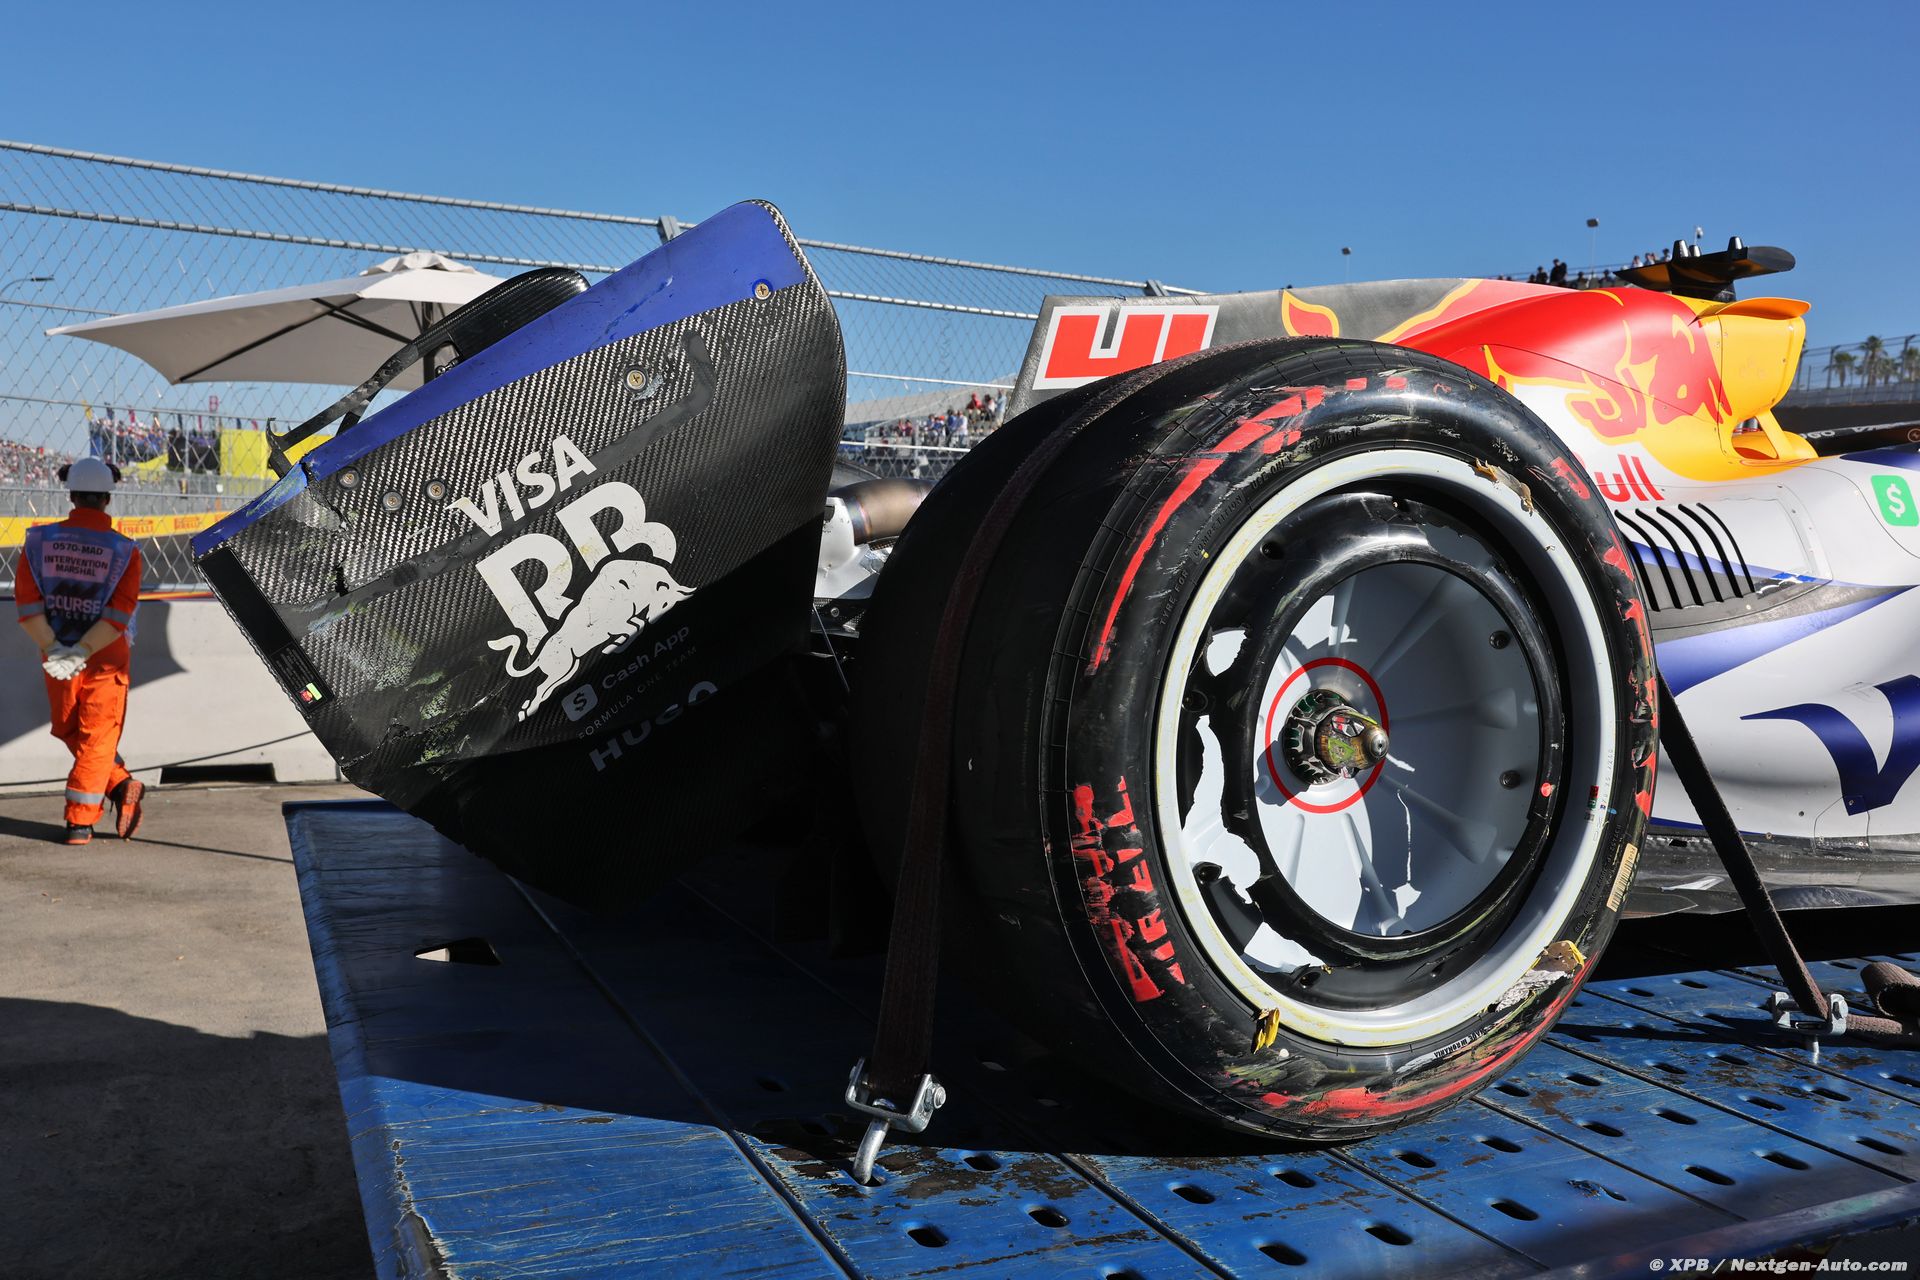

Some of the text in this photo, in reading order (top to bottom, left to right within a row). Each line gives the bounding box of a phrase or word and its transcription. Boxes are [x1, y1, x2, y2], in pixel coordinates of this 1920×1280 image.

[445, 434, 597, 537] VISA
[1572, 452, 1665, 502] ull
[44, 555, 108, 570] INTERVENTION
[52, 542, 104, 556] 0570-MAD
[1160, 598, 1176, 626] TYRE
[1176, 569, 1188, 593] FOR
[1251, 472, 1270, 489] USE
[55, 564, 96, 577] MARSHAL
[45, 594, 102, 614] COURSE
[602, 652, 650, 690] Cash
[653, 625, 690, 658] App
[577, 645, 698, 740] FORMULA ONE TEAM
[1433, 1042, 1461, 1058] ROMANIA
